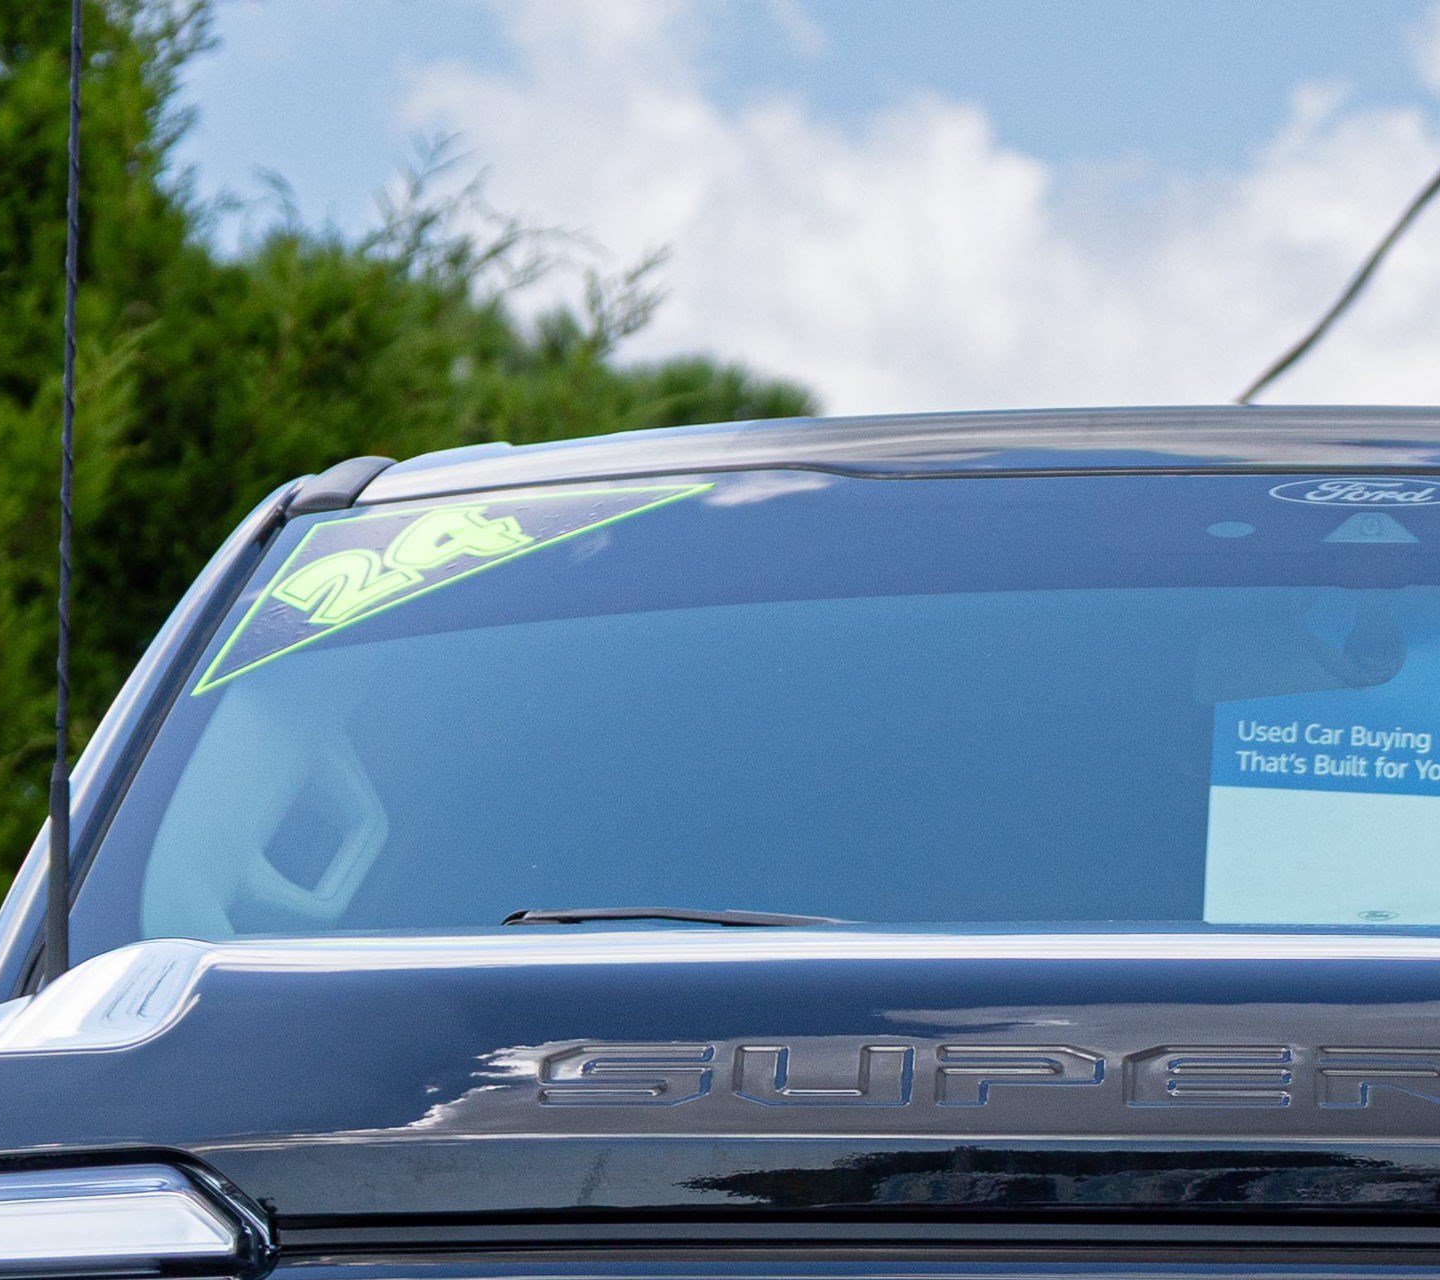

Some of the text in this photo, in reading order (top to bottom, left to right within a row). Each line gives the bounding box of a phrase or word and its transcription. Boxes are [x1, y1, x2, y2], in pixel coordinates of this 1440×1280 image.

[1305, 480, 1436, 502] Ford
[271, 505, 536, 625] 24
[1237, 720, 1433, 753] Used Car Buying
[1236, 751, 1307, 775] That's
[1313, 754, 1367, 778] Built
[1374, 757, 1409, 779] for
